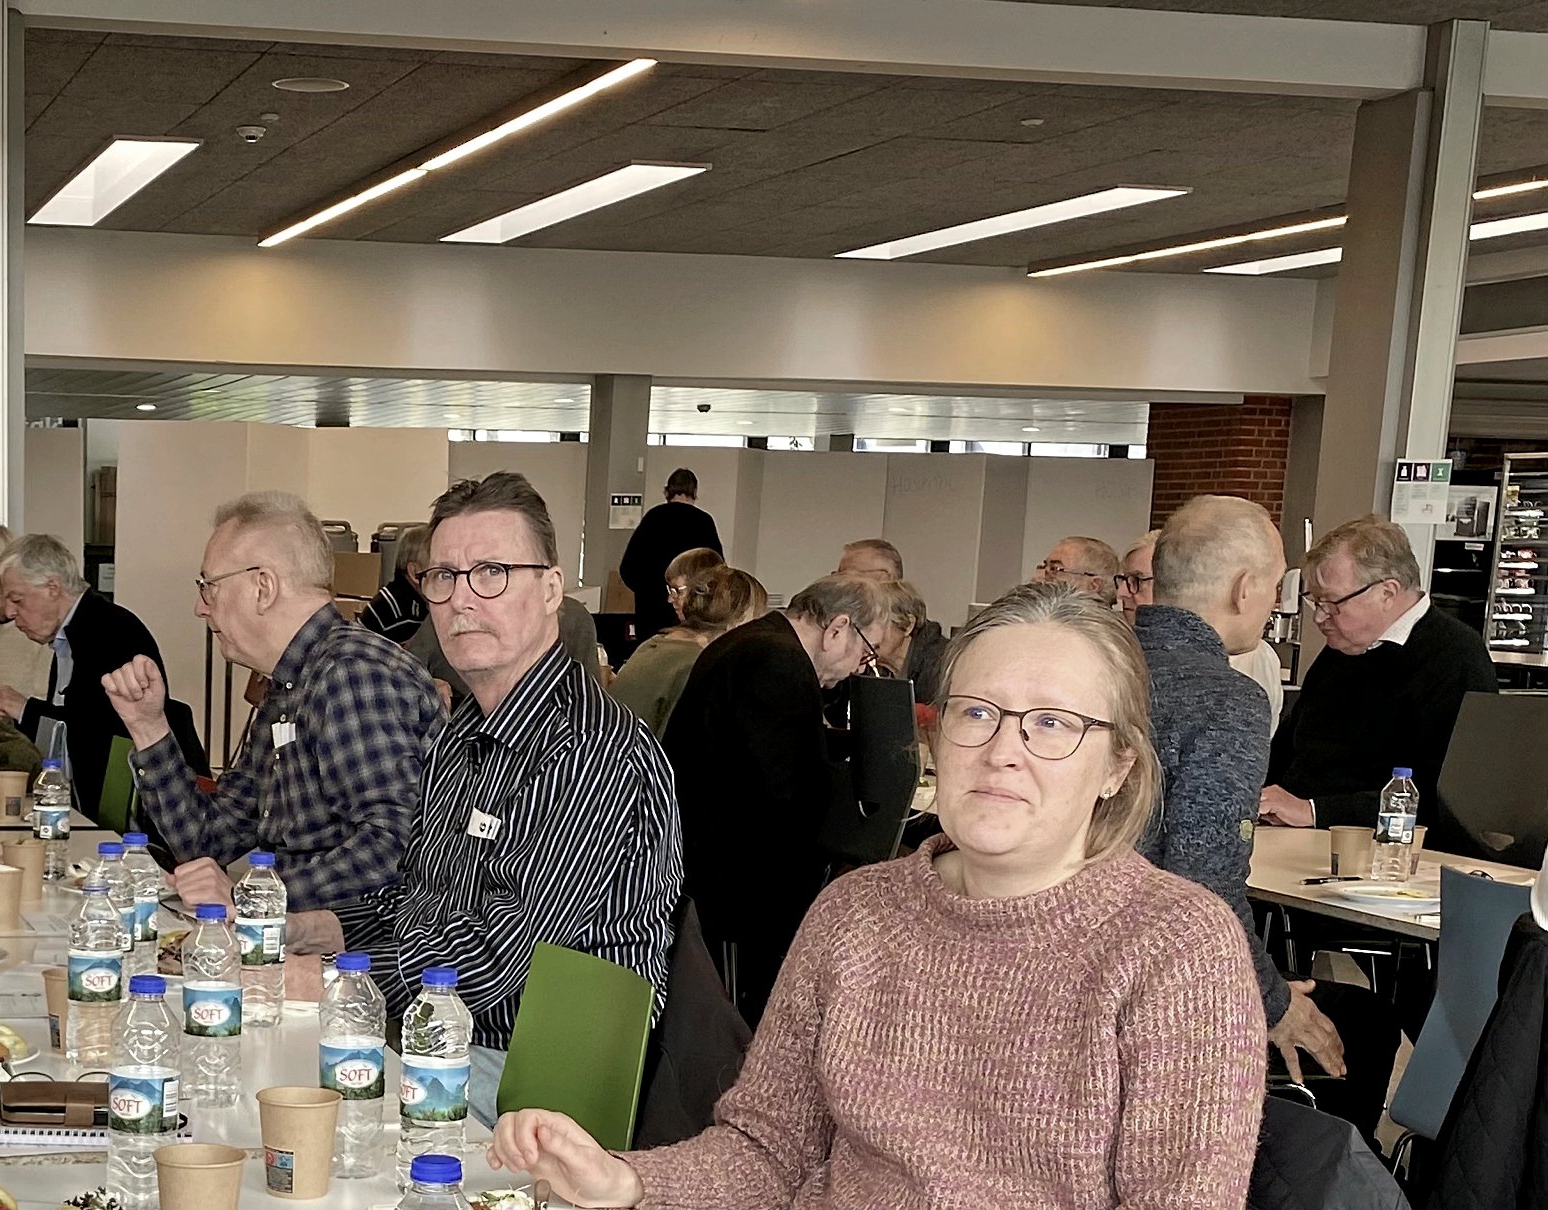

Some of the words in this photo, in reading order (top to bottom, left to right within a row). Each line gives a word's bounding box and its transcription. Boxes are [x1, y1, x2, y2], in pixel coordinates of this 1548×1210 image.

[85, 974, 113, 987] SOFT
[193, 1007, 224, 1021] SOFT
[339, 1067, 373, 1082] SOFT
[399, 1084, 419, 1100] OFT
[112, 1098, 144, 1114] SOFT
